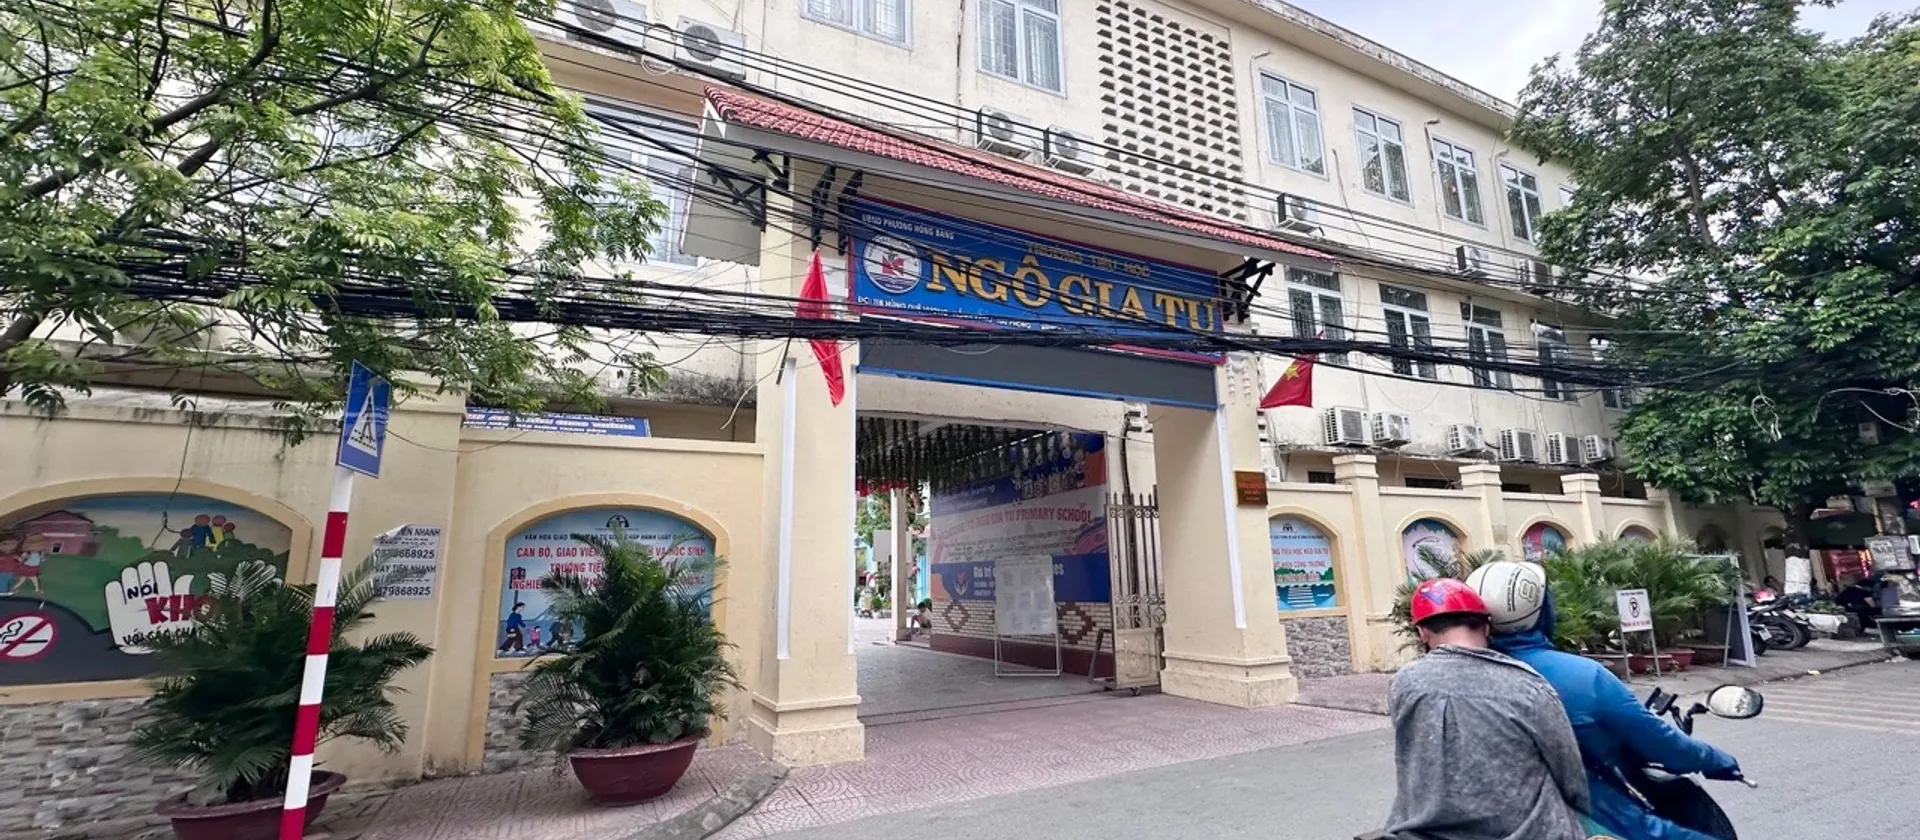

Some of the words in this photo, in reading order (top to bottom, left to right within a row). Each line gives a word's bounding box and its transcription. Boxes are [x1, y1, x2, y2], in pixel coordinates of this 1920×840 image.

[926, 253, 1052, 308] NGÔ
[1057, 274, 1148, 321] GIA
[1016, 509, 1056, 521] PRIMARY
[1057, 509, 1093, 525] SCHOOL
[415, 528, 440, 537] NHANH
[127, 579, 158, 599] NÓI
